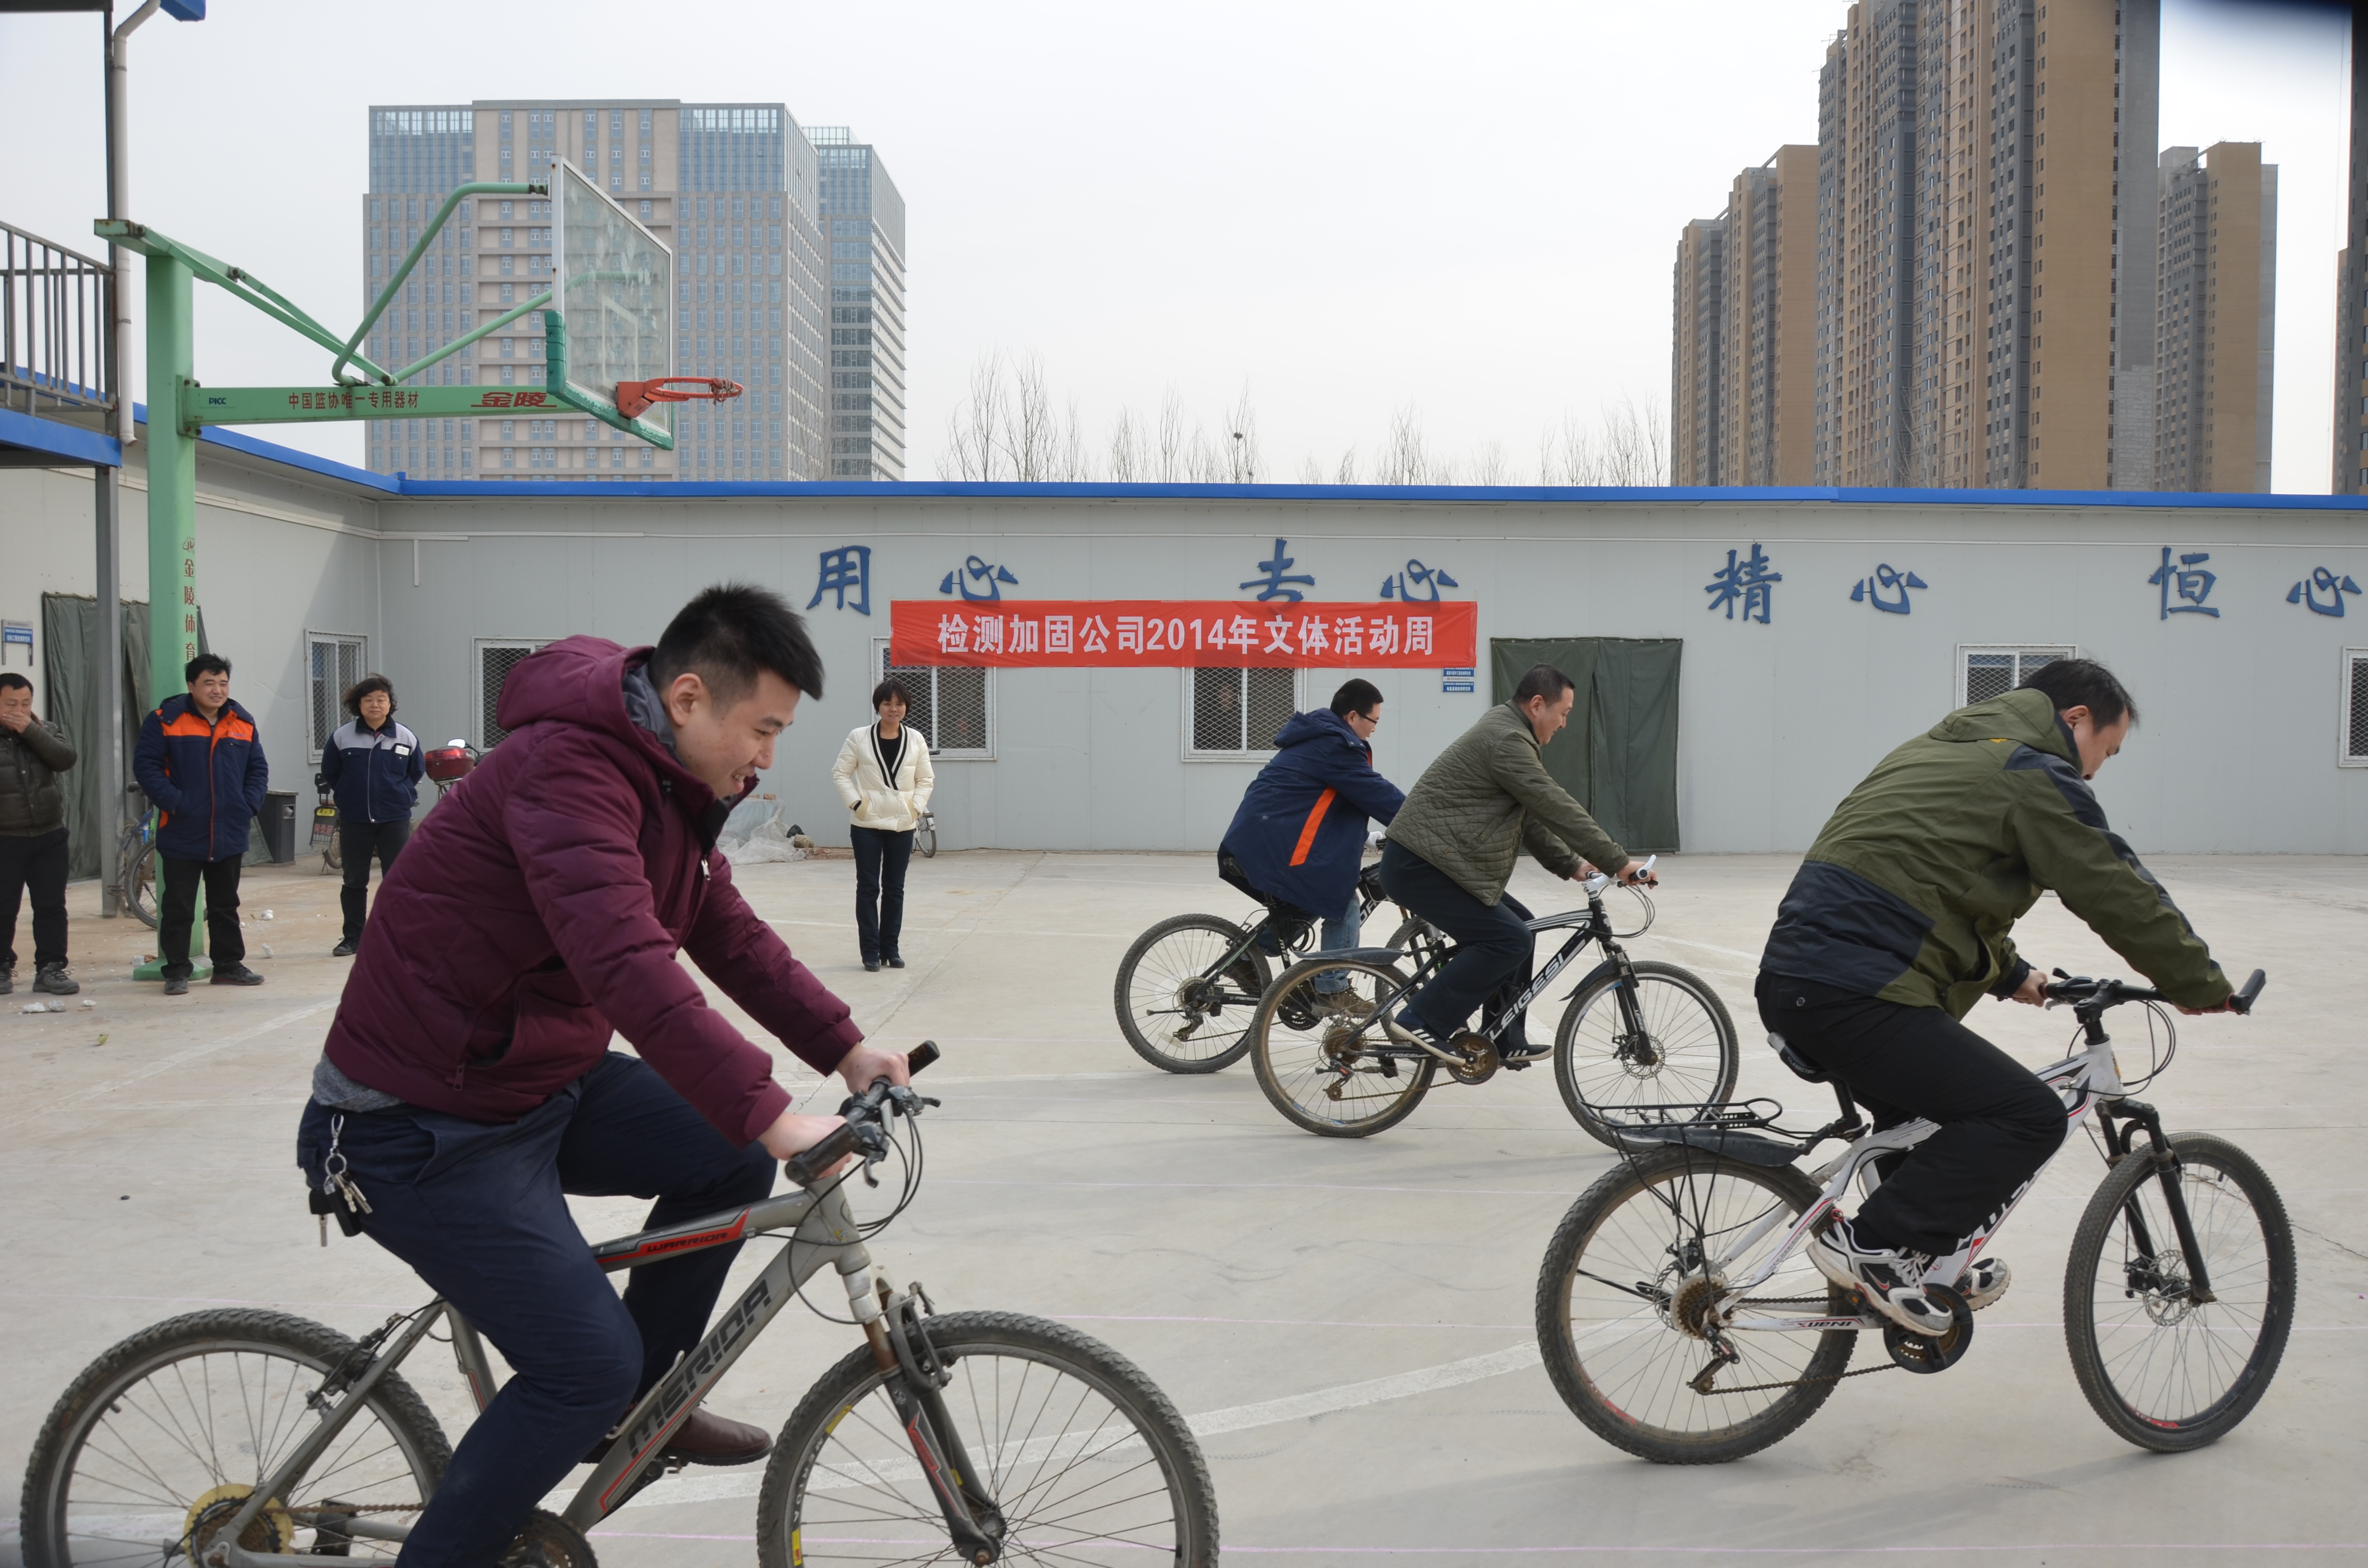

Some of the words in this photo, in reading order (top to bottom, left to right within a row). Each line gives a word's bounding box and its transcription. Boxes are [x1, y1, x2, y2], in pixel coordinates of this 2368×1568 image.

[289, 391, 419, 409] 中国篮协唯一专用器材
[471, 392, 557, 407] 金陵
[185, 558, 196, 662] 金陵体育
[806, 545, 1018, 616] 用心
[1705, 544, 1928, 624] 精心
[2148, 547, 2362, 620] 恒心
[937, 613, 1433, 656] 检测加固公司2014年文体活动周
[1489, 952, 1564, 1040] LEIGESI
[647, 1232, 728, 1253] WARRIOR
[627, 1279, 772, 1459] MERIDA
